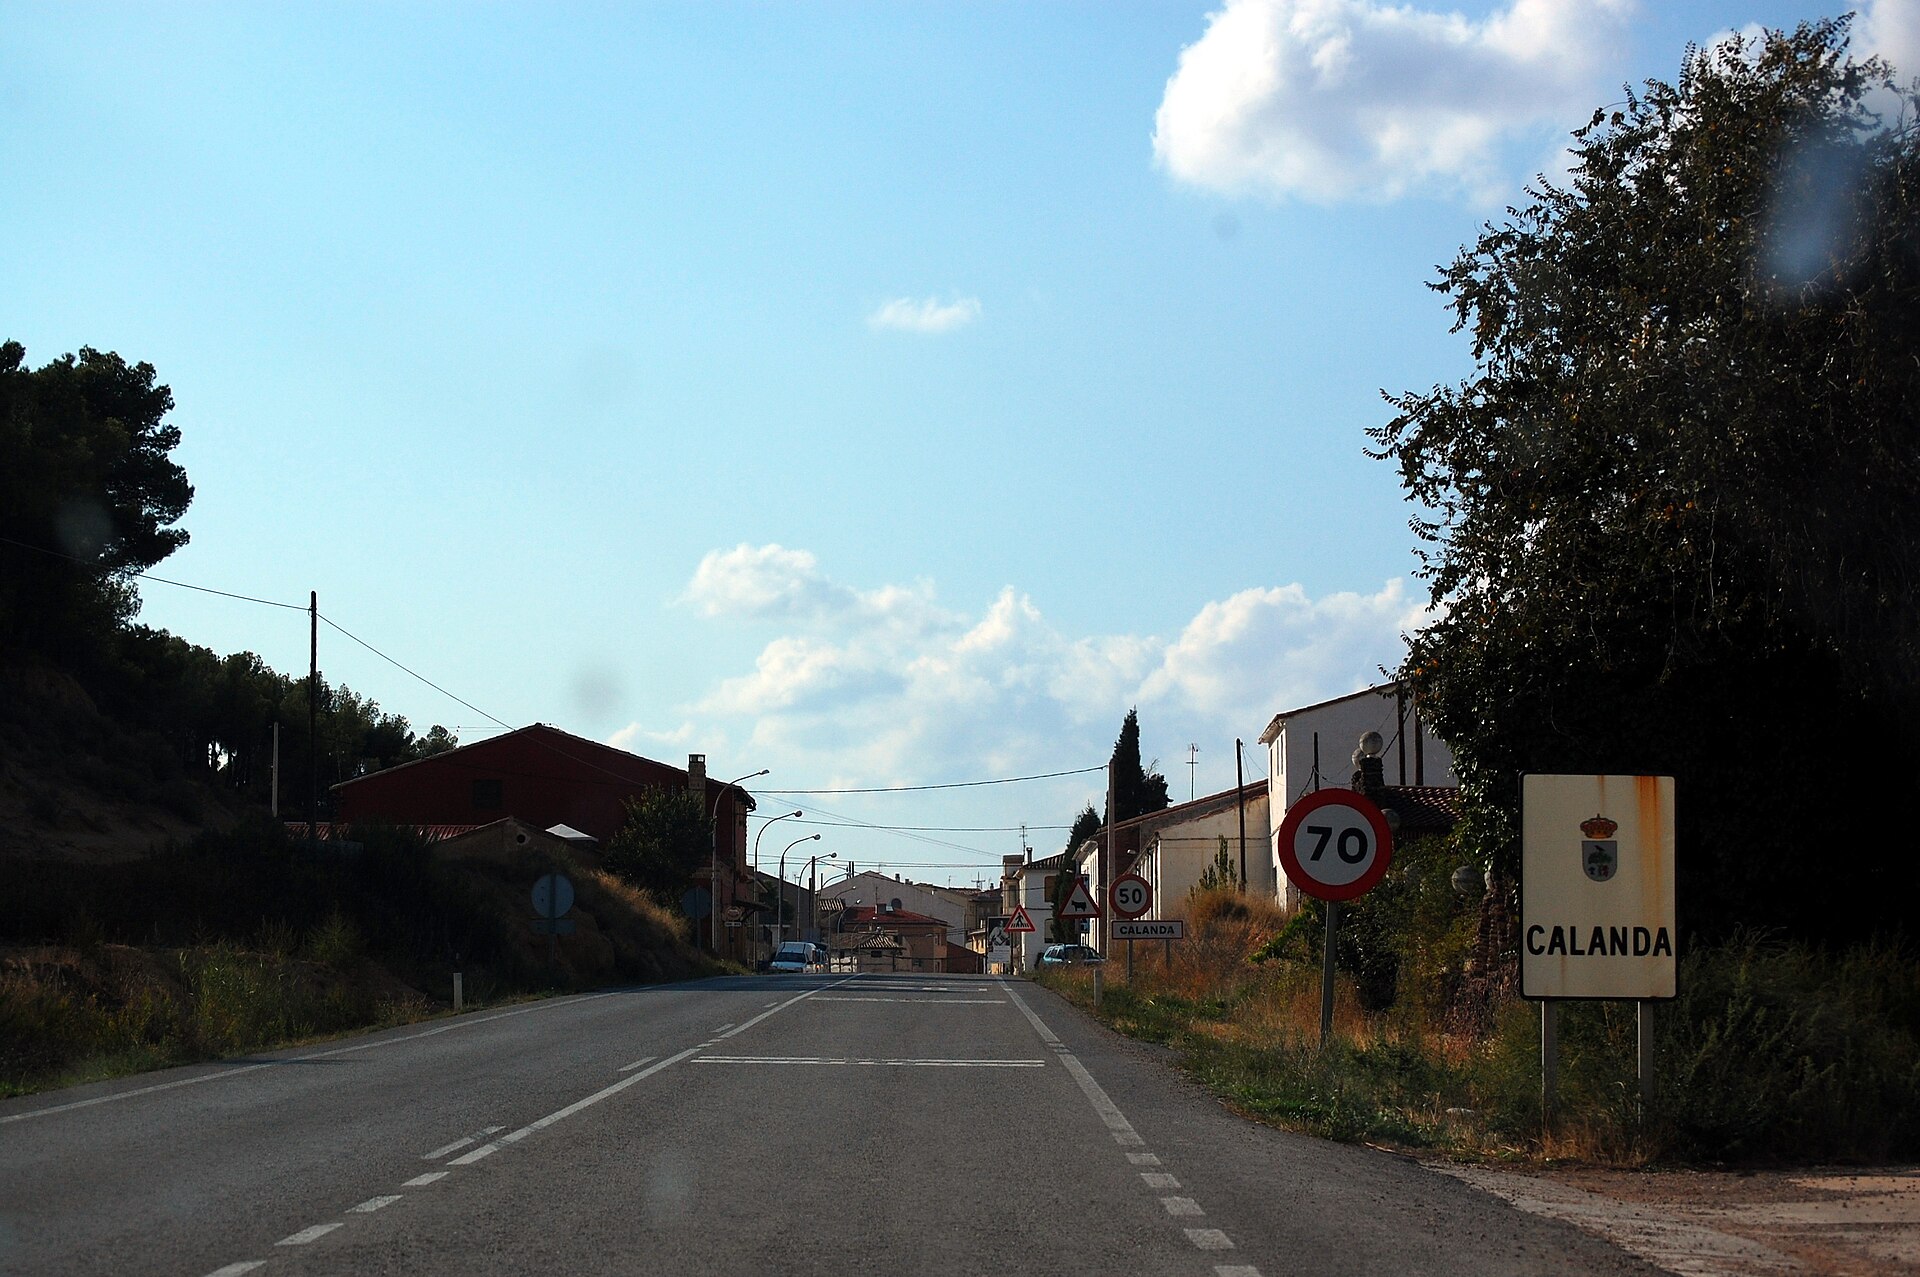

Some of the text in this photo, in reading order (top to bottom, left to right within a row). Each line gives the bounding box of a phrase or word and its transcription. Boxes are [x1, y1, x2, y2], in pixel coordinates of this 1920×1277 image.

[1307, 826, 1368, 864] 70
[1120, 888, 1142, 904] 50
[1120, 926, 1175, 935] CALANDA
[1526, 925, 1672, 957] CALANDA
